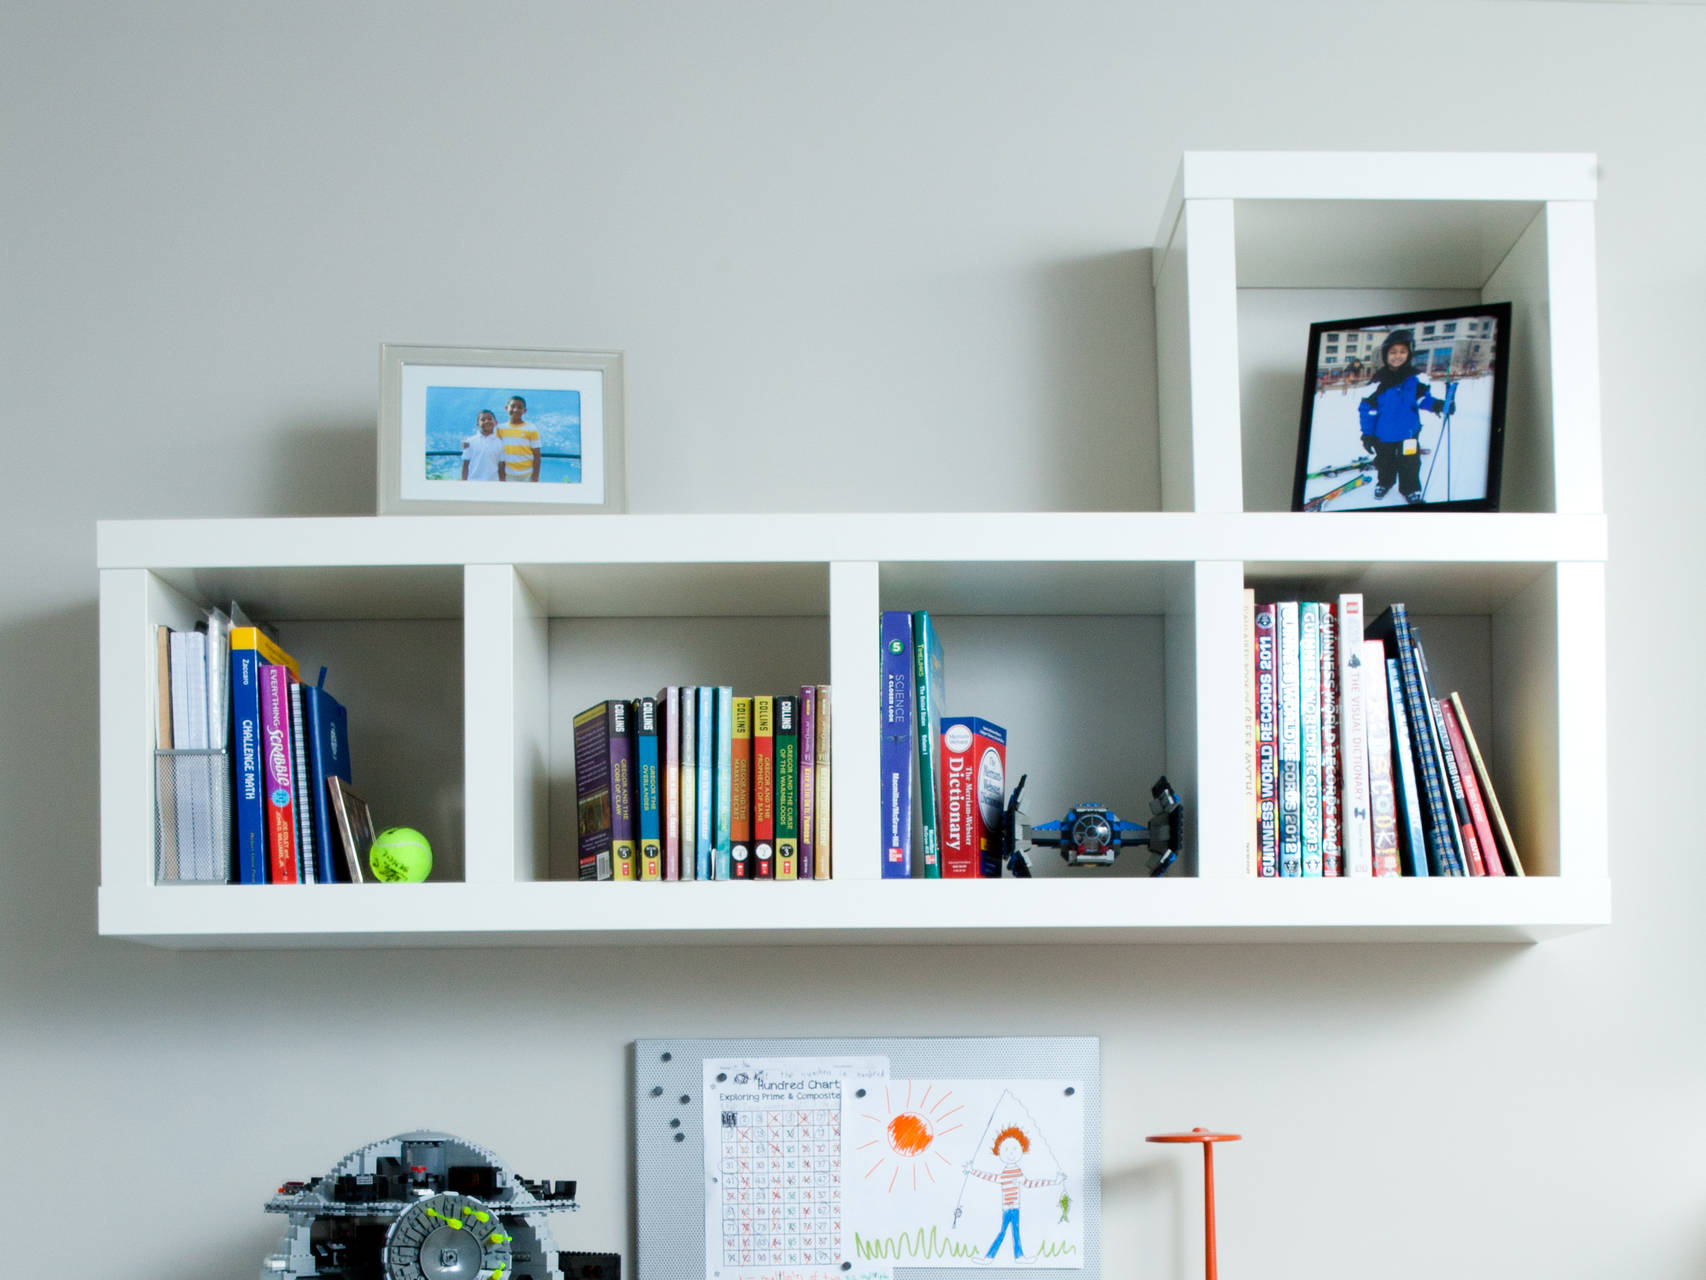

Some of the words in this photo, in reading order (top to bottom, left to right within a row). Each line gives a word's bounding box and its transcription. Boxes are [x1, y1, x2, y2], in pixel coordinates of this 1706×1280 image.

[892, 641, 902, 653] 5
[1259, 636, 1272, 670] 2011
[1282, 607, 1297, 684] GUINNESS
[1303, 612, 1316, 688] GUINNESS
[1322, 612, 1335, 689] GUINNESS
[242, 659, 250, 685] Zaccaro
[1351, 671, 1361, 691] THE
[269, 669, 280, 726] EVERYTHING
[643, 702, 654, 730] COLLINS
[759, 701, 768, 731] COLLINS
[781, 701, 791, 730] COLLINS
[895, 674, 904, 723] SCIENCE
[1259, 673, 1273, 742] RECORDS
[1282, 687, 1297, 740] WORLD
[1352, 697, 1362, 734] VISUAL
[1431, 698, 1442, 724] STAR
[615, 703, 625, 733] COLLINS
[737, 702, 746, 733] COLLINS
[1304, 691, 1317, 743] WORLD
[1323, 691, 1336, 743] WORLD
[243, 719, 256, 771] CHALLENGE
[1438, 724, 1451, 750] WARS
[620, 758, 628, 787] GREGOR
[965, 766, 973, 781] The
[1260, 745, 1274, 798] WORLD
[1283, 743, 1297, 812] RECORDS
[1305, 746, 1317, 816] RECORDS
[1324, 746, 1337, 815] RECORDS
[1353, 737, 1364, 801] DICTIONARY
[1444, 750, 1458, 775] FOLDED
[245, 773, 256, 799] MATH
[946, 757, 964, 851] Dictionary
[1450, 774, 1465, 799] FLYERS
[965, 783, 973, 845] Merriam-Webster
[1373, 779, 1396, 855] COOK!
[1261, 801, 1275, 877] GUINNESS
[1284, 813, 1298, 854] 2012
[1306, 820, 1318, 853] 2013
[1324, 817, 1338, 854] 2014
[720, 1093, 759, 1102] Exploring
[762, 1093, 785, 1101] Prime
[788, 1092, 794, 1100] &
[796, 1092, 841, 1101] Composite
[758, 1079, 804, 1090] Hundred
[808, 1079, 840, 1090] Chart
